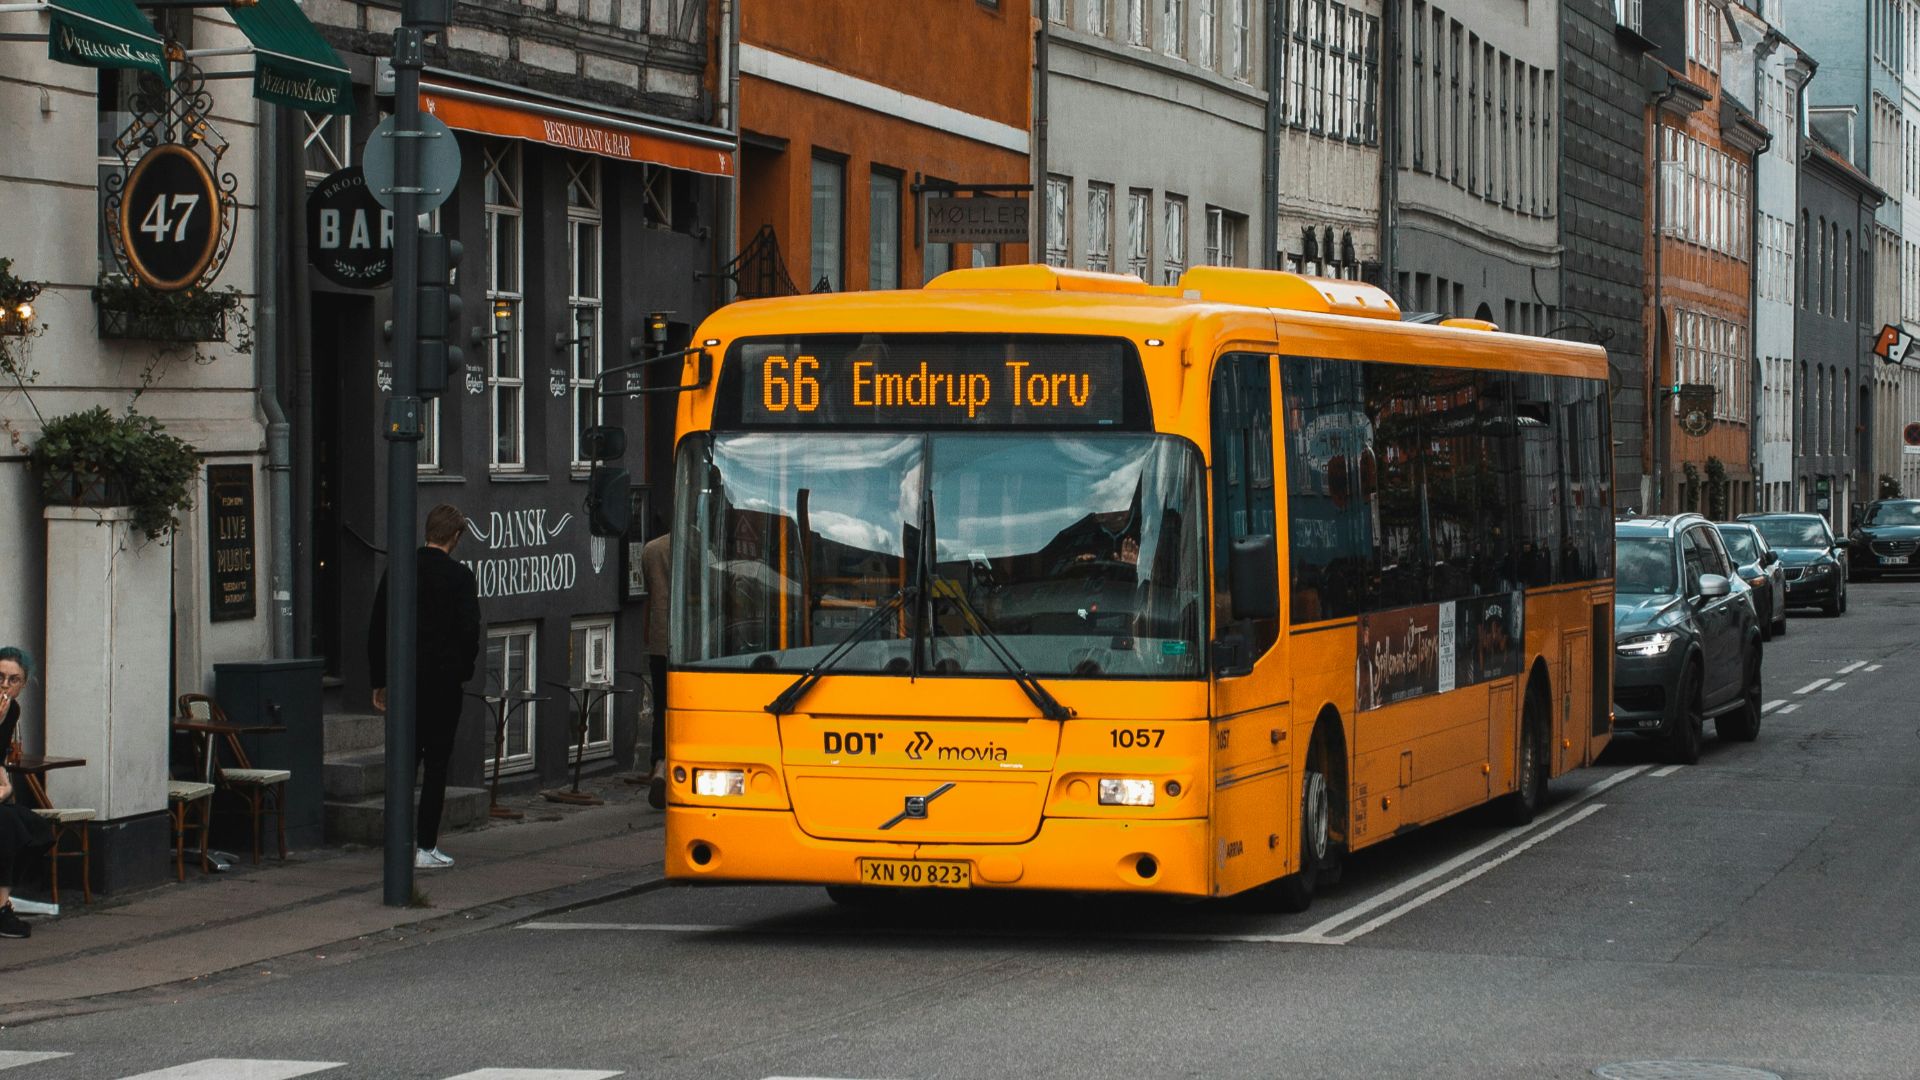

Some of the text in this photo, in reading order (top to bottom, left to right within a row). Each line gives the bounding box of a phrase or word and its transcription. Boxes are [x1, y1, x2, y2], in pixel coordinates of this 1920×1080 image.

[543, 120, 631, 157] RESTAURANT & BAR
[324, 176, 367, 198] BROO
[140, 193, 199, 243] 47
[928, 206, 1026, 223] MØLLER
[320, 208, 394, 249] BAR
[762, 354, 1090, 418] 66 Emdrup Torv
[220, 515, 246, 540] LIVE
[489, 508, 547, 550] DANSK
[216, 547, 251, 573] MUSIC
[461, 553, 576, 599] MØRREBRØD
[823, 731, 881, 755] DOT
[938, 741, 1007, 761] movia
[1110, 729, 1165, 748] 1057
[1216, 729, 1230, 750] 1057
[871, 863, 961, 884] XN 90 823
